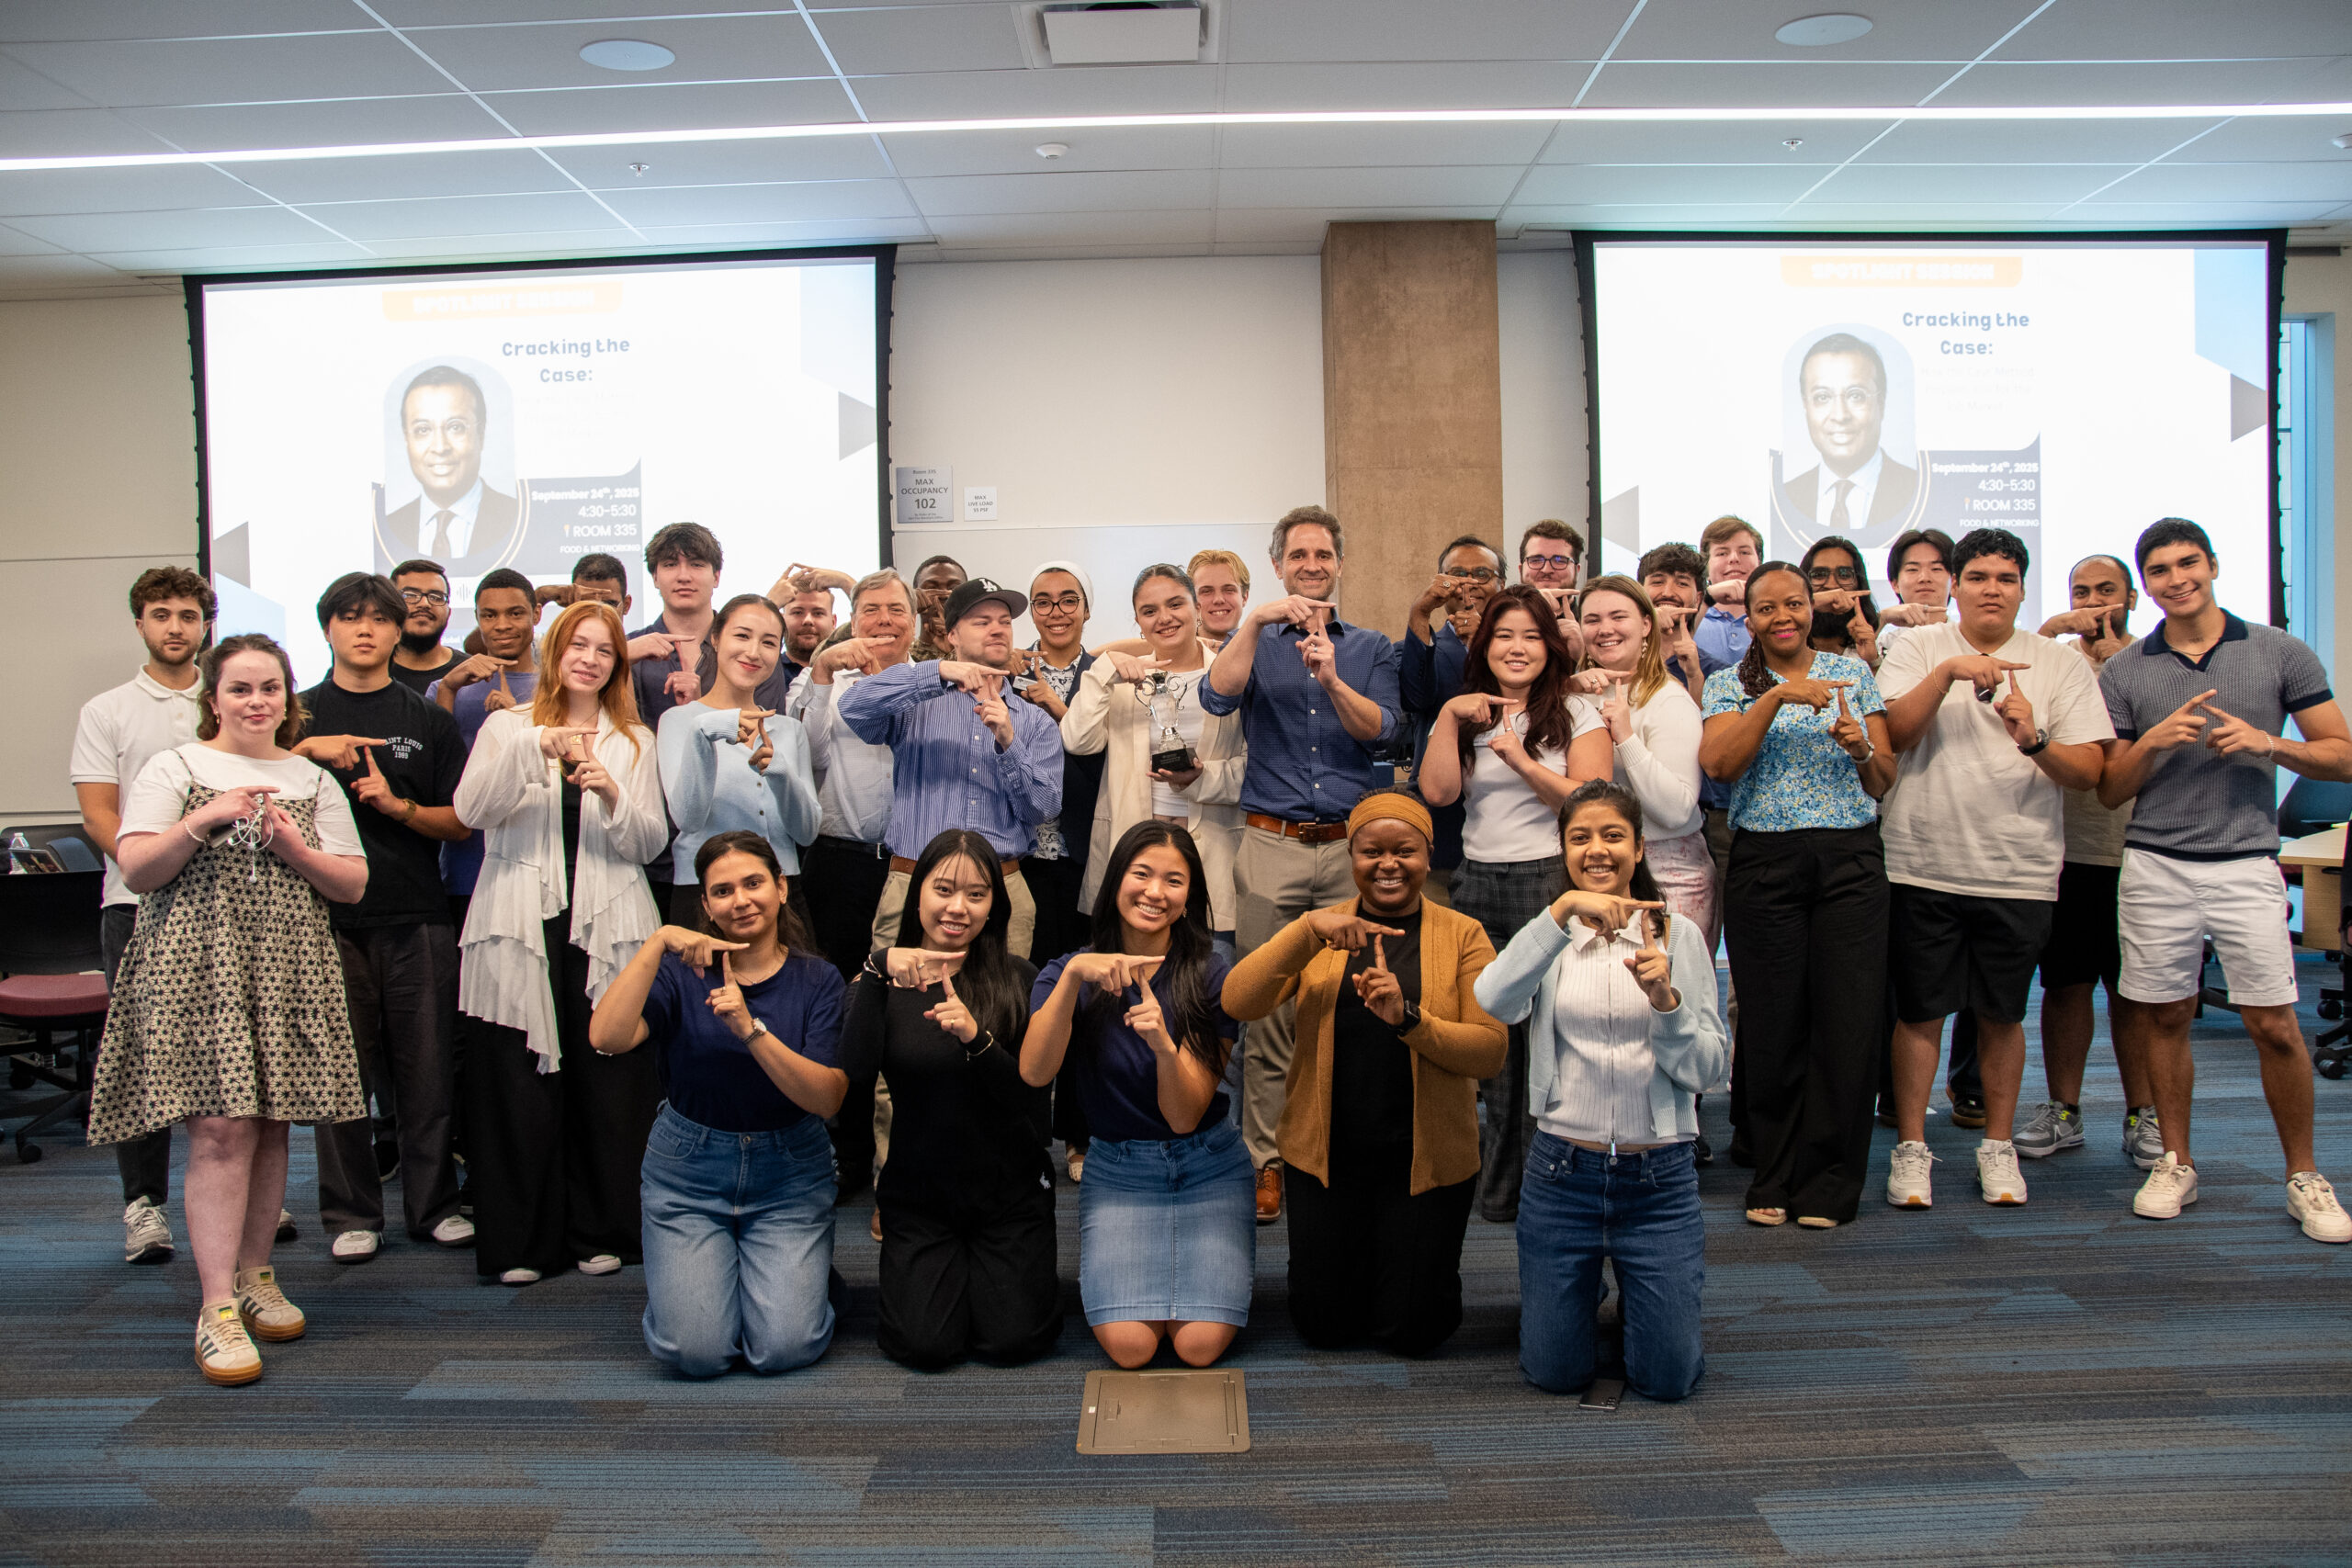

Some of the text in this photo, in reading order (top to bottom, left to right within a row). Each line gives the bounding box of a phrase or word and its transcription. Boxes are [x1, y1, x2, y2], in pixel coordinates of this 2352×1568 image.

[1902, 310, 2030, 331] Cracking the
[502, 338, 630, 358] Cracking the
[1940, 340, 1994, 355] Case:
[539, 368, 594, 383] Case:
[1931, 462, 1989, 476] September
[2014, 462, 2039, 473] 2025
[531, 489, 589, 503] September
[900, 487, 949, 495] OCCUPANCY
[914, 498, 937, 509] 102
[1973, 499, 2036, 512] ROOM 335
[1960, 519, 1982, 527] FOOD
[1990, 519, 2040, 527] NETWORKING
[573, 524, 637, 537] ROOM 335
[560, 545, 582, 554] FOOD
[383, 737, 424, 750] AINT LOUIS
[392, 744, 412, 752] PARIS
